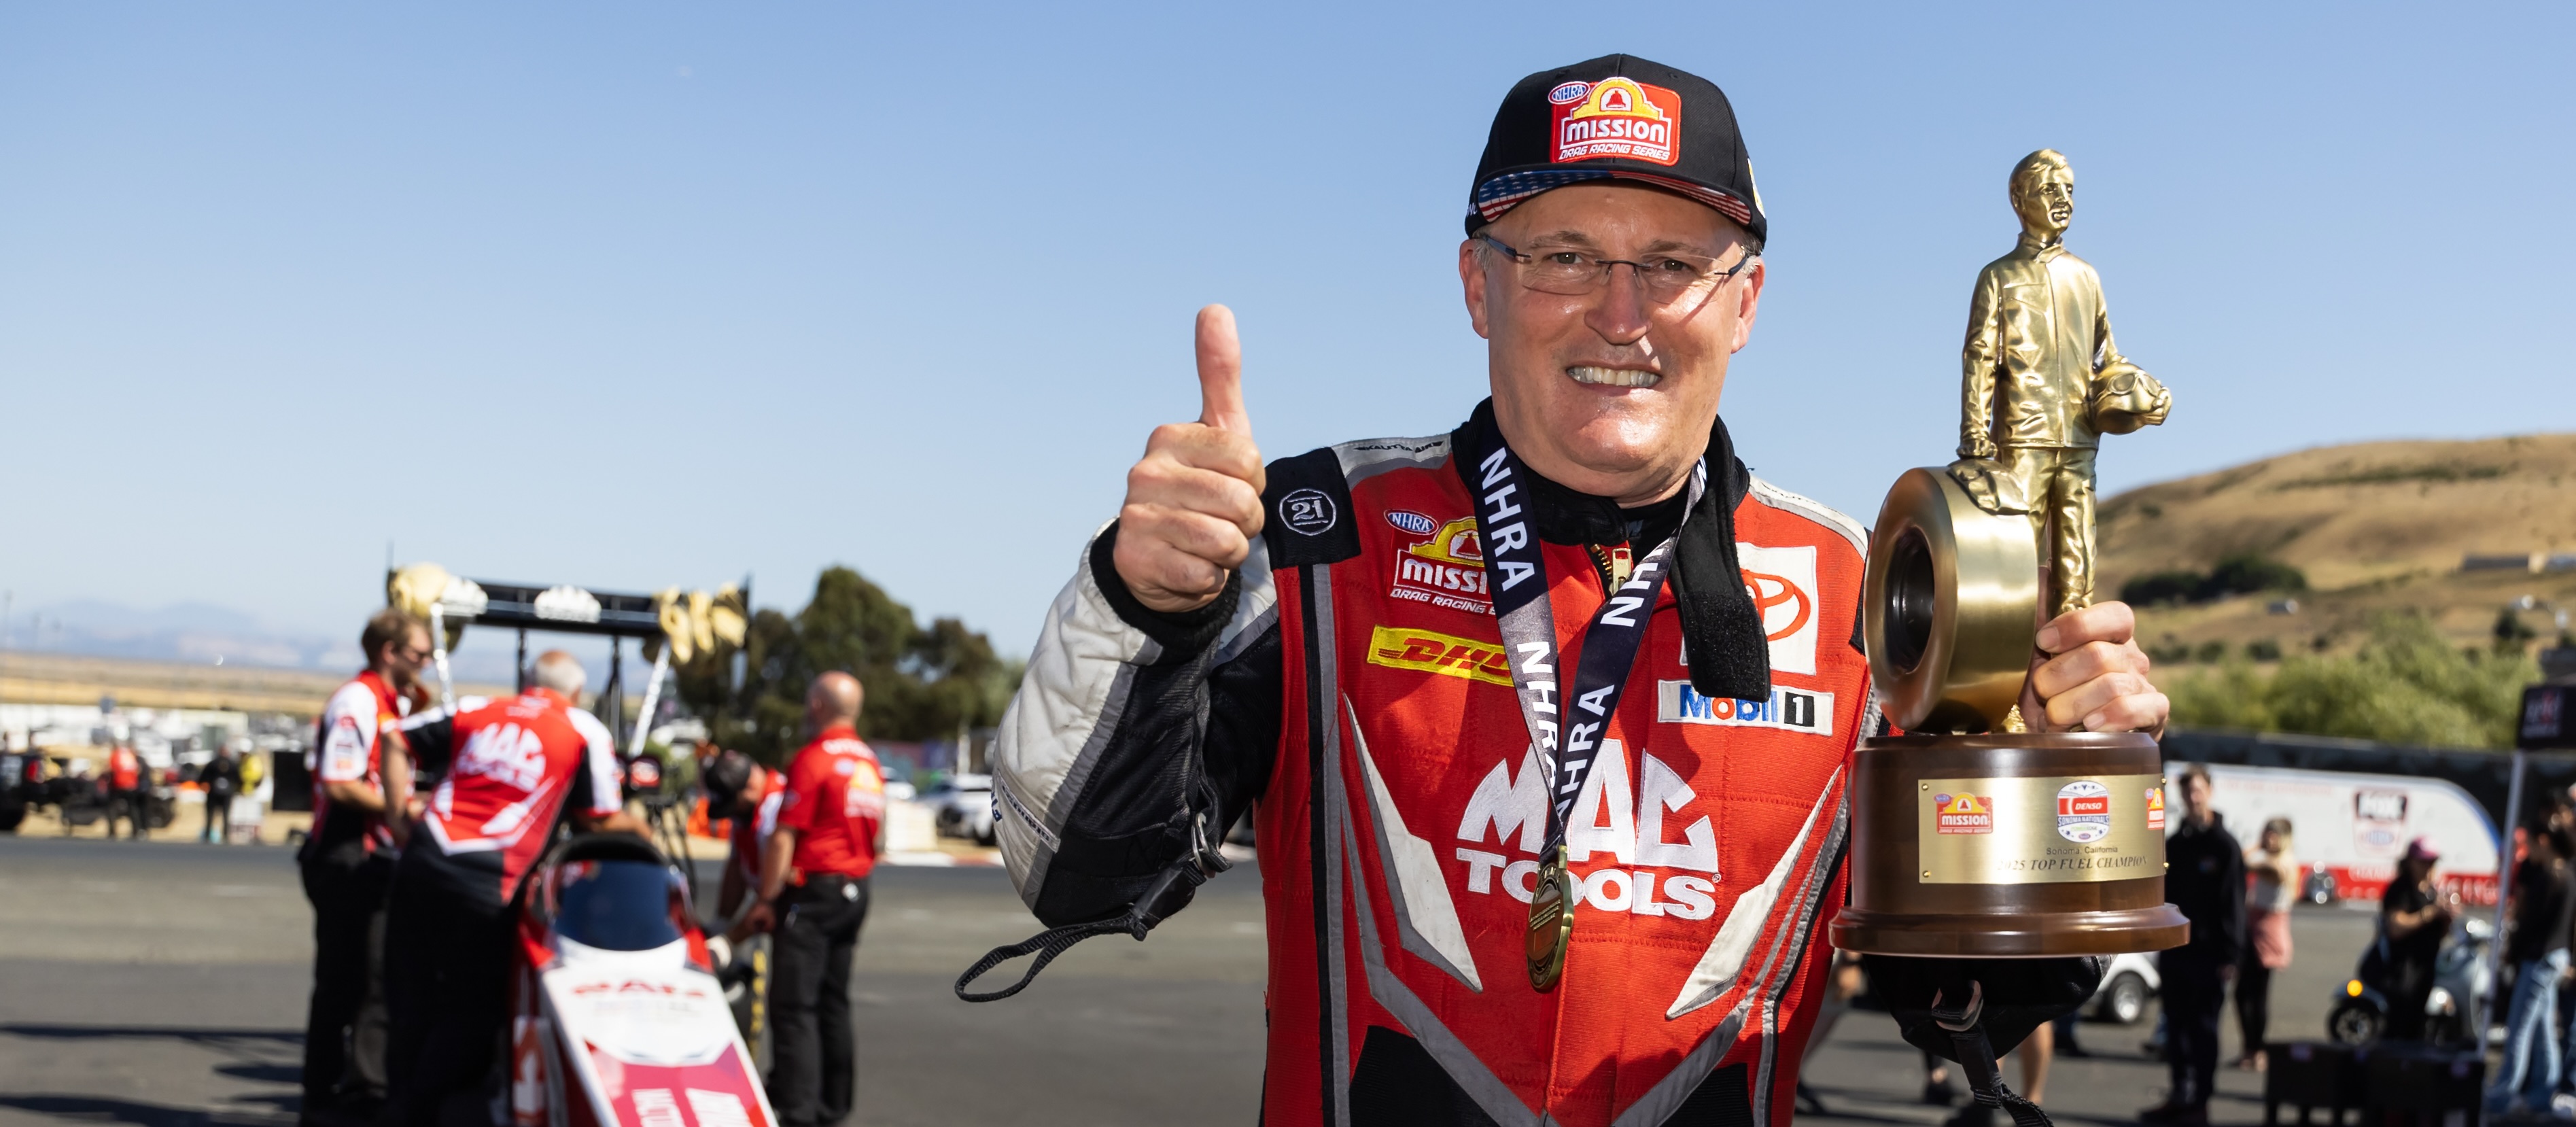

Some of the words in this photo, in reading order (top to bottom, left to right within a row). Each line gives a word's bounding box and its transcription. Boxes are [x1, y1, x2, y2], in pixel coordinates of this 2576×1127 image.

[1554, 84, 1584, 101] NHRA
[1559, 145, 1587, 160] DRAG
[1588, 143, 1631, 155] RACING
[1631, 145, 1671, 161] SERIES
[1291, 500, 1325, 521] 21
[1480, 447, 1535, 592] NHRA
[1392, 512, 1431, 532] NHRA
[1402, 558, 1488, 595] MISSI
[1390, 588, 1431, 602] DRAG
[1431, 595, 1486, 614] RACING
[1399, 637, 1511, 678] DHL
[1792, 696, 1804, 725] 1
[1457, 738, 1719, 874] MAC
[2074, 802, 2103, 810] DENSO
[2046, 847, 2082, 856] Sonoma,
[2084, 846, 2119, 854] California
[2030, 859, 2057, 871] TOP
[2059, 858, 2093, 871] FUEL
[2096, 855, 2148, 869] CHAMPION
